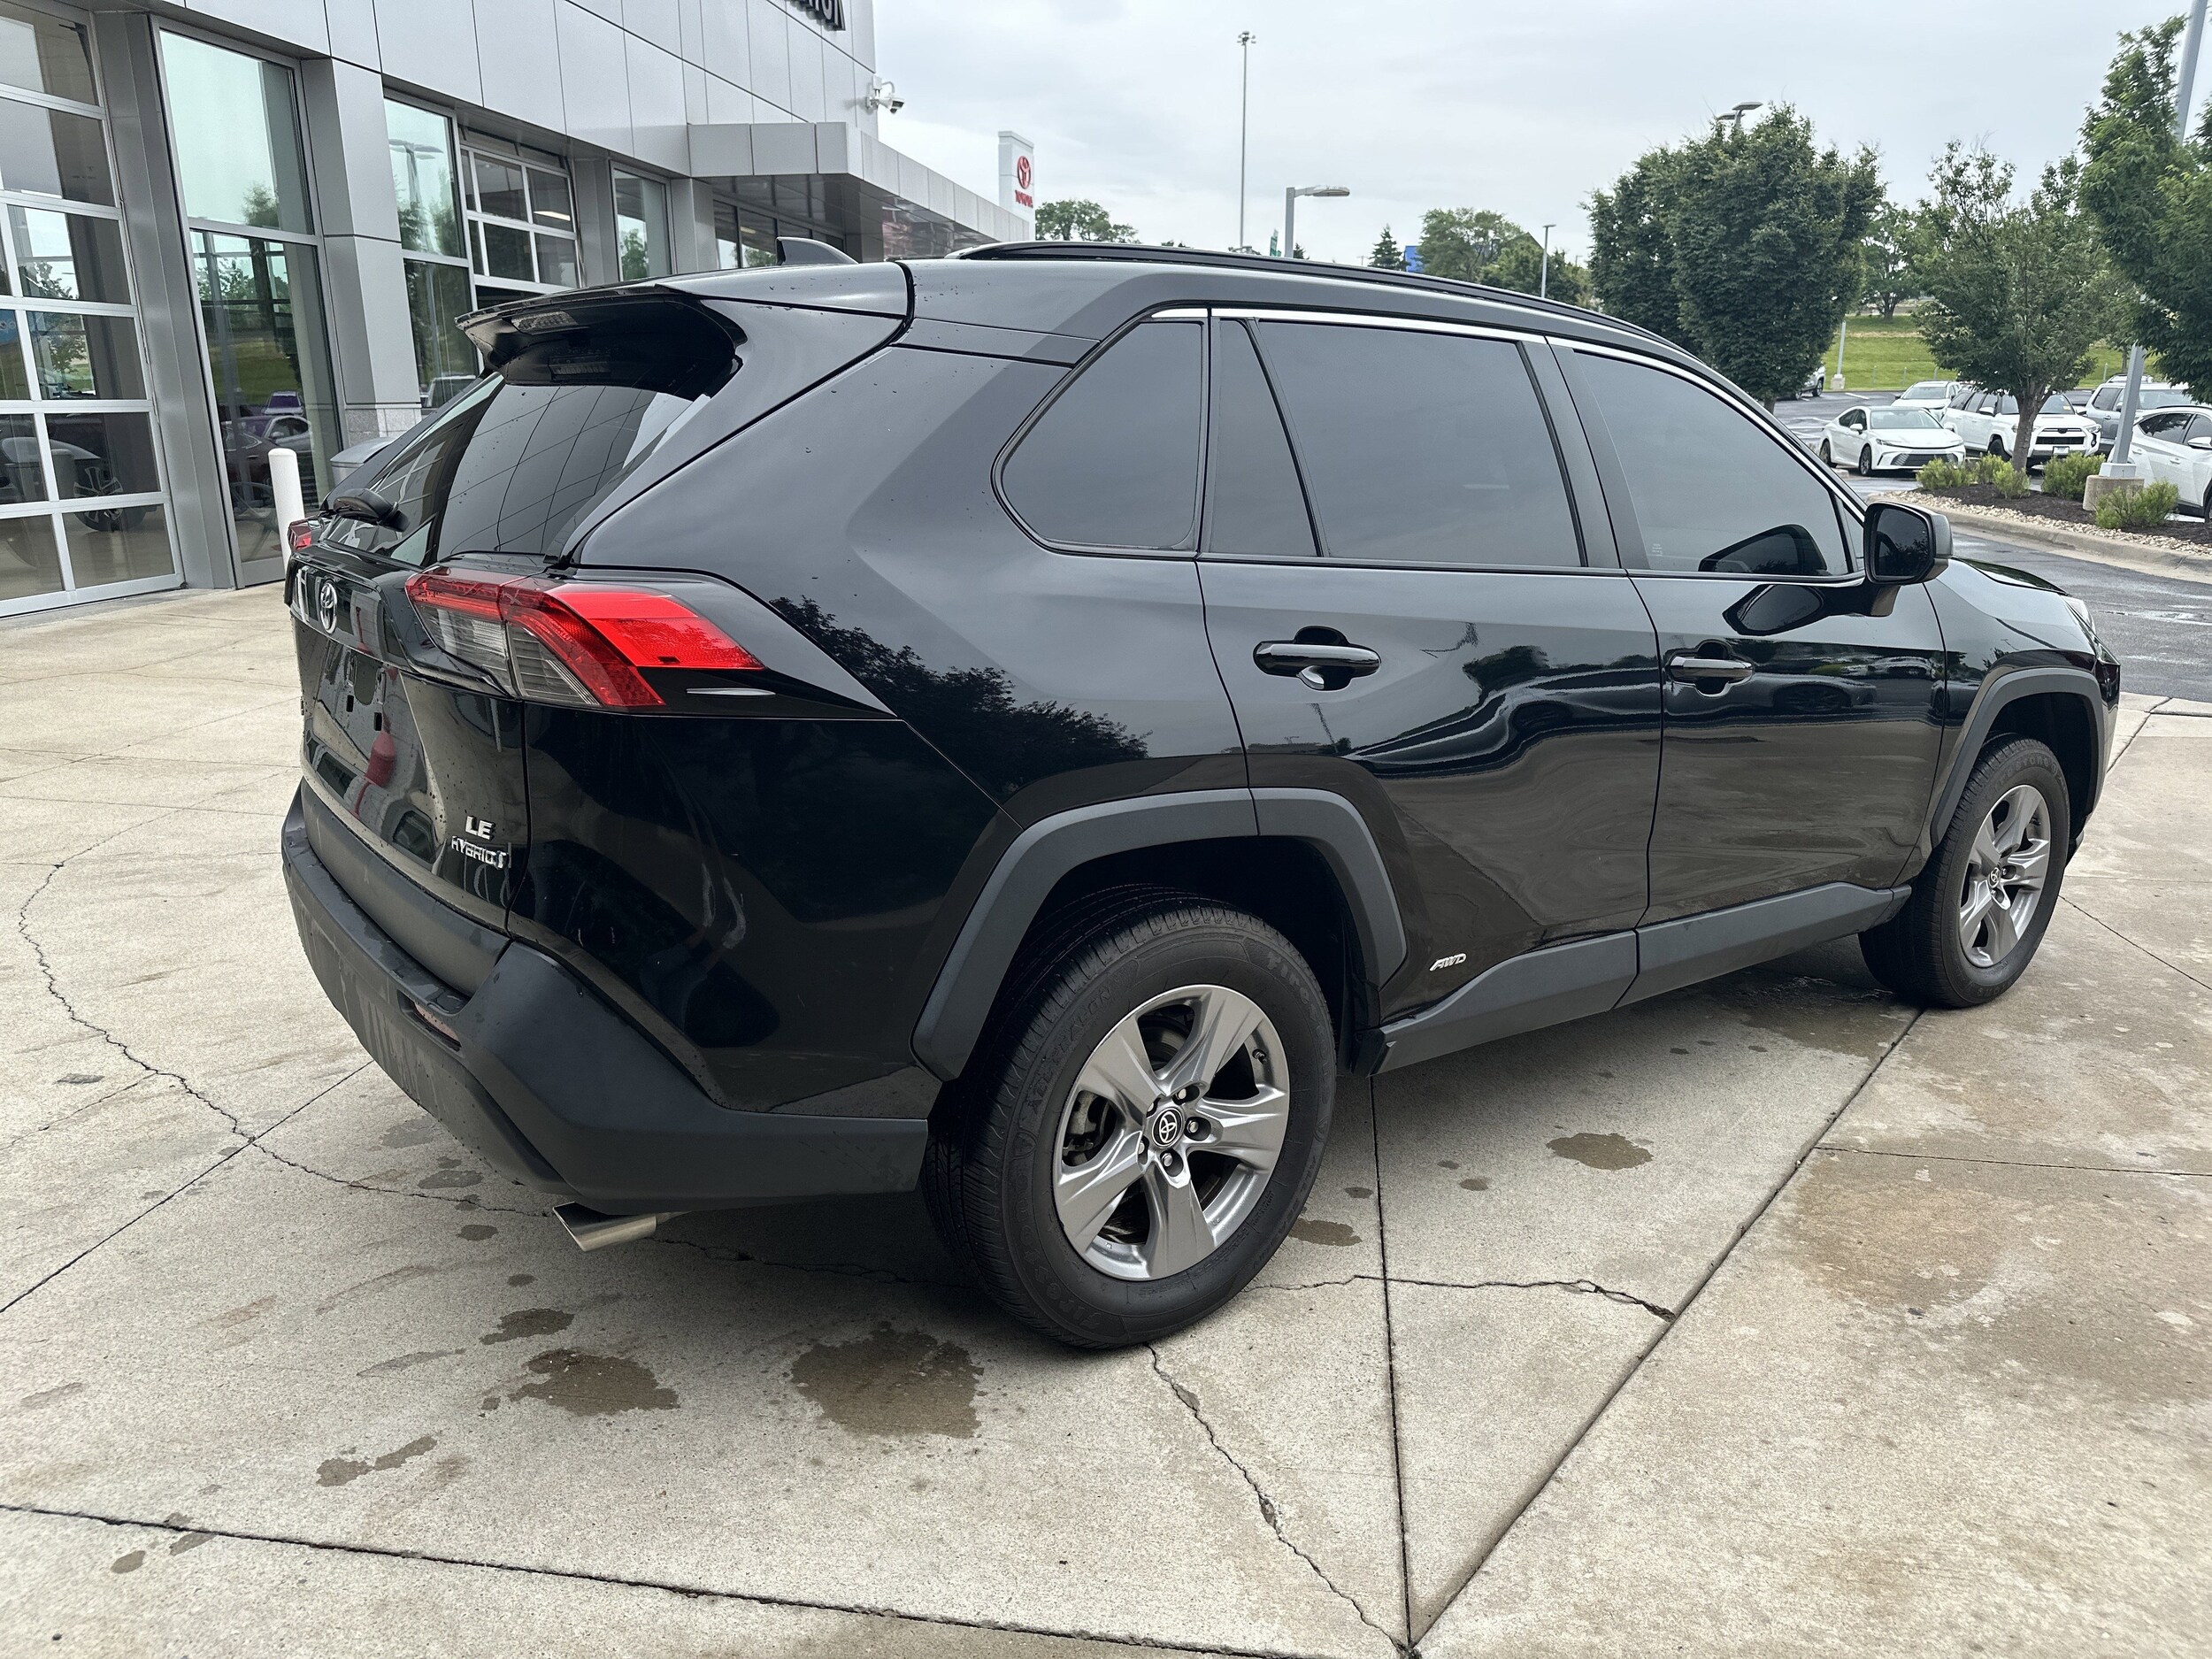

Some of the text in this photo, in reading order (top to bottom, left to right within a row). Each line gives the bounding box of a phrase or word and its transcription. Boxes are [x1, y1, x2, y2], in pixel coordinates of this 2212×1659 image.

[465, 816, 493, 840] LE
[451, 835, 497, 866] HYBRID
[1429, 953, 1467, 972] AWD
